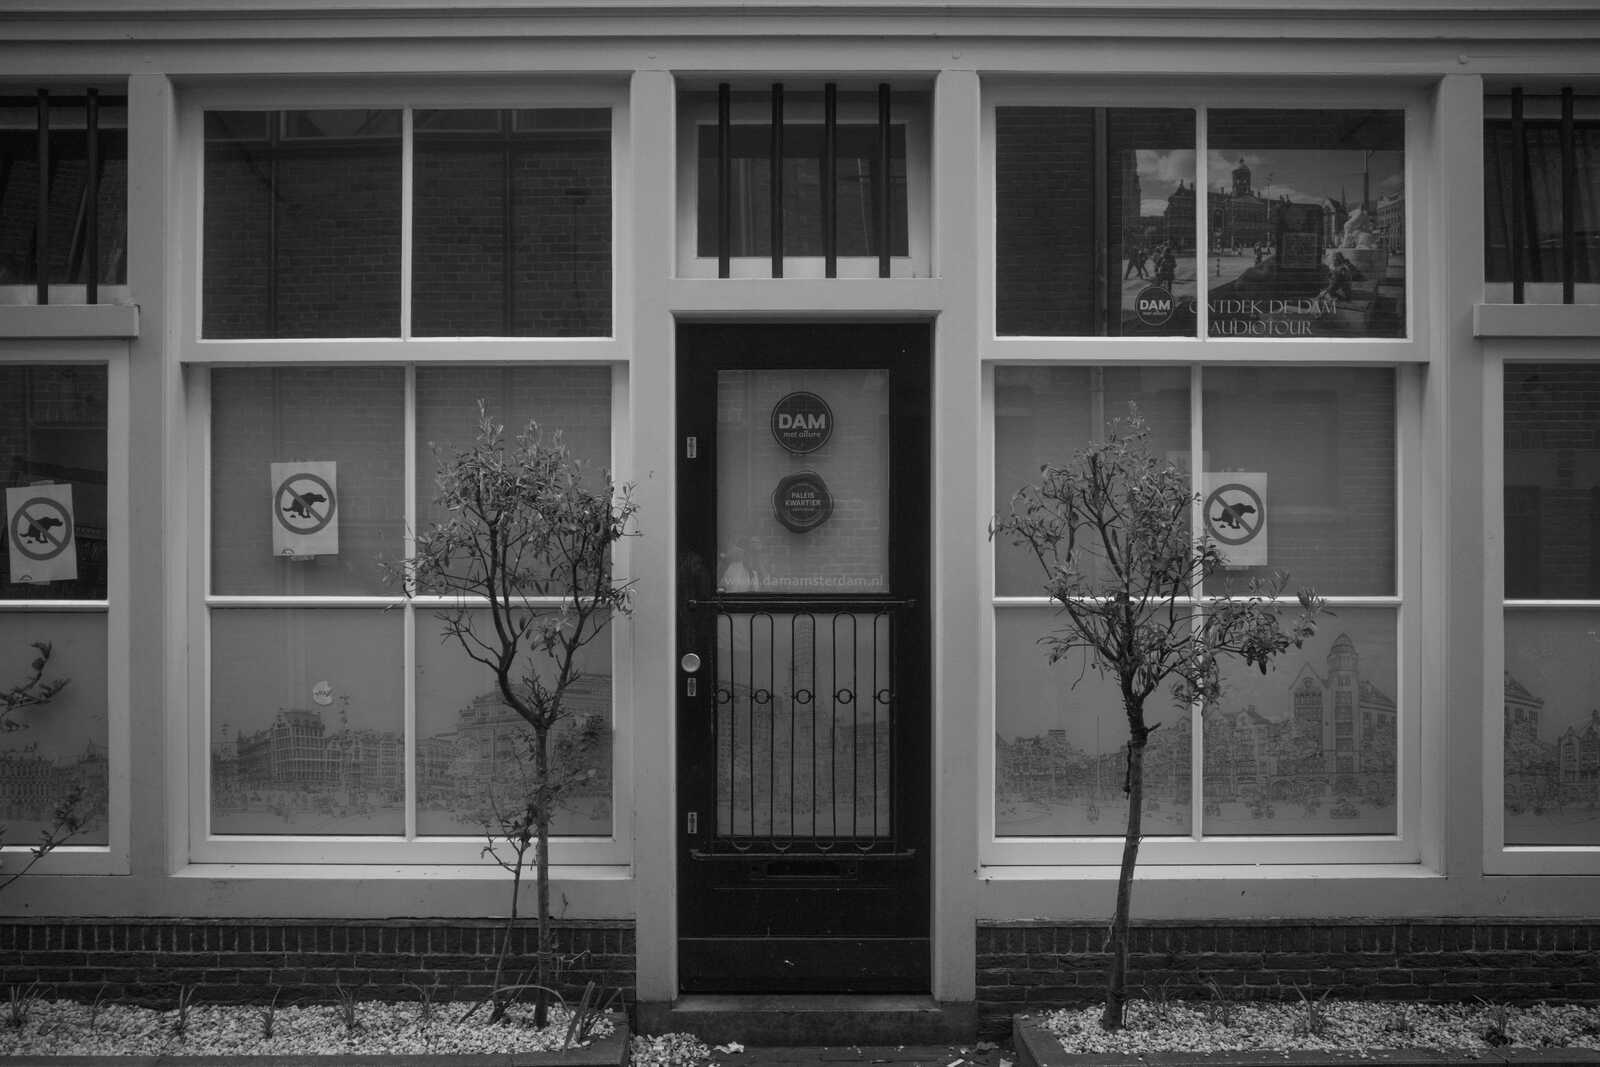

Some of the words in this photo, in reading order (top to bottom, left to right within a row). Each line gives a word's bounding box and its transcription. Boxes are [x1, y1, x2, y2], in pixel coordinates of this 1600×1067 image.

[1139, 300, 1171, 311] DAM
[1270, 299, 1289, 314] DE
[1298, 299, 1337, 314] DAM
[1211, 320, 1313, 335] AUDIOTOUR
[779, 414, 826, 429] DAM
